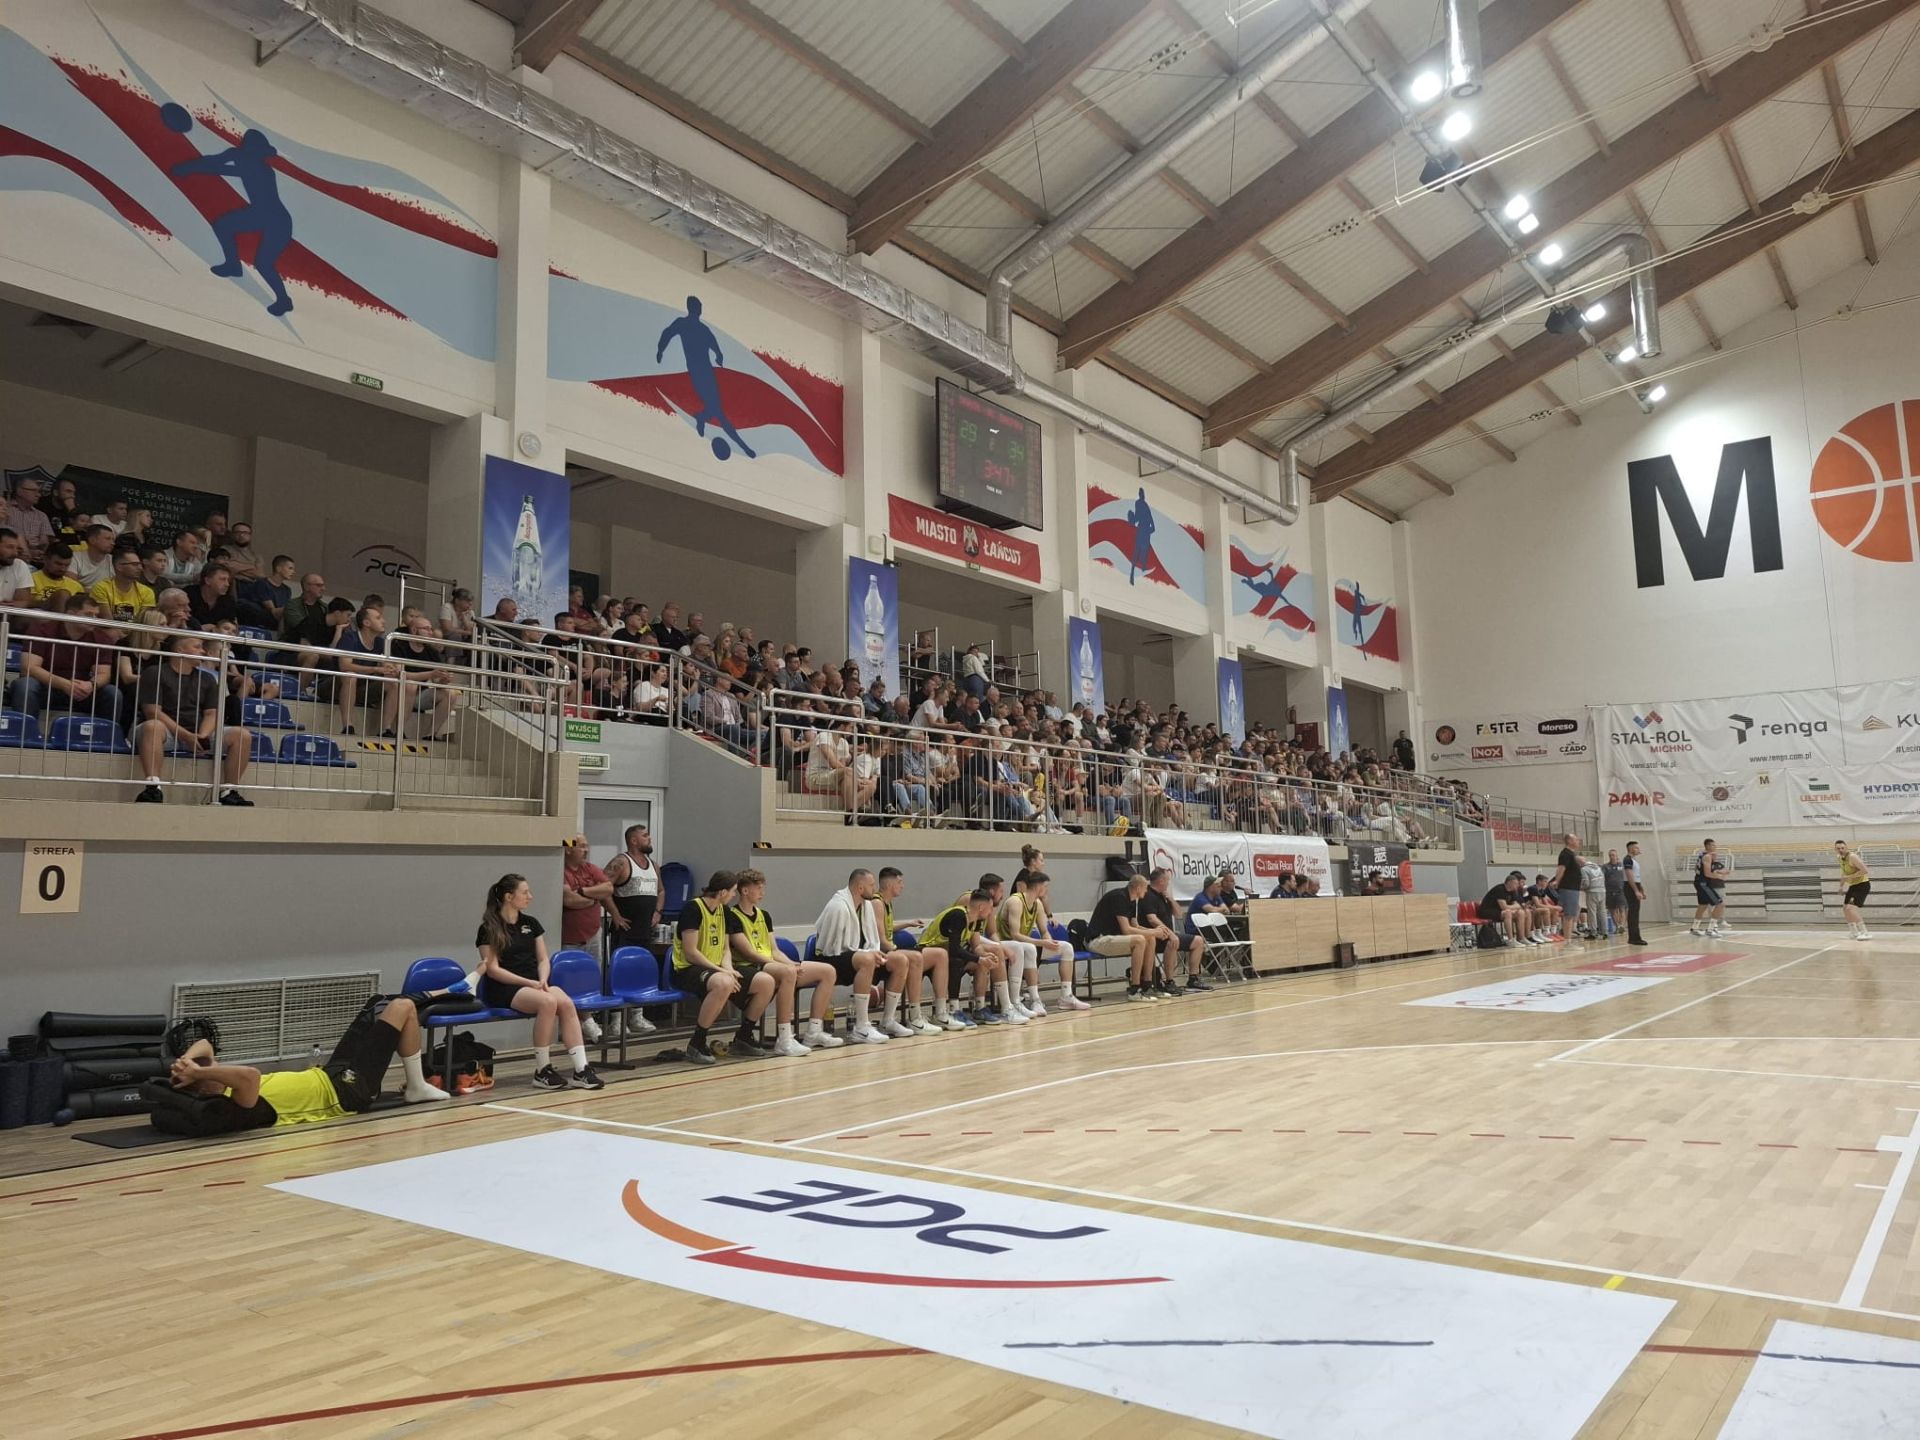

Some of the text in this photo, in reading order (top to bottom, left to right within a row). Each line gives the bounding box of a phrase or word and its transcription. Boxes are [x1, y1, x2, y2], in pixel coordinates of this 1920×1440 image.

[144, 491, 192, 505] SPONSOR
[915, 515, 1022, 566] MIASTO ŁAŃCUT
[365, 558, 411, 580] PGE
[1476, 721, 1520, 736] FASTER
[1541, 722, 1575, 732] Moreso
[1761, 719, 1829, 737] renga
[1611, 730, 1692, 745] STAL-ROL
[1472, 747, 1501, 758] INOX
[1650, 743, 1693, 753] MICHNO
[1759, 775, 1770, 785] M
[33, 846, 76, 856] STREFA
[1182, 853, 1245, 876] Bank Pekao
[1267, 860, 1279, 871] Bank
[38, 864, 66, 901] 0
[702, 1180, 1111, 1255] PGE
